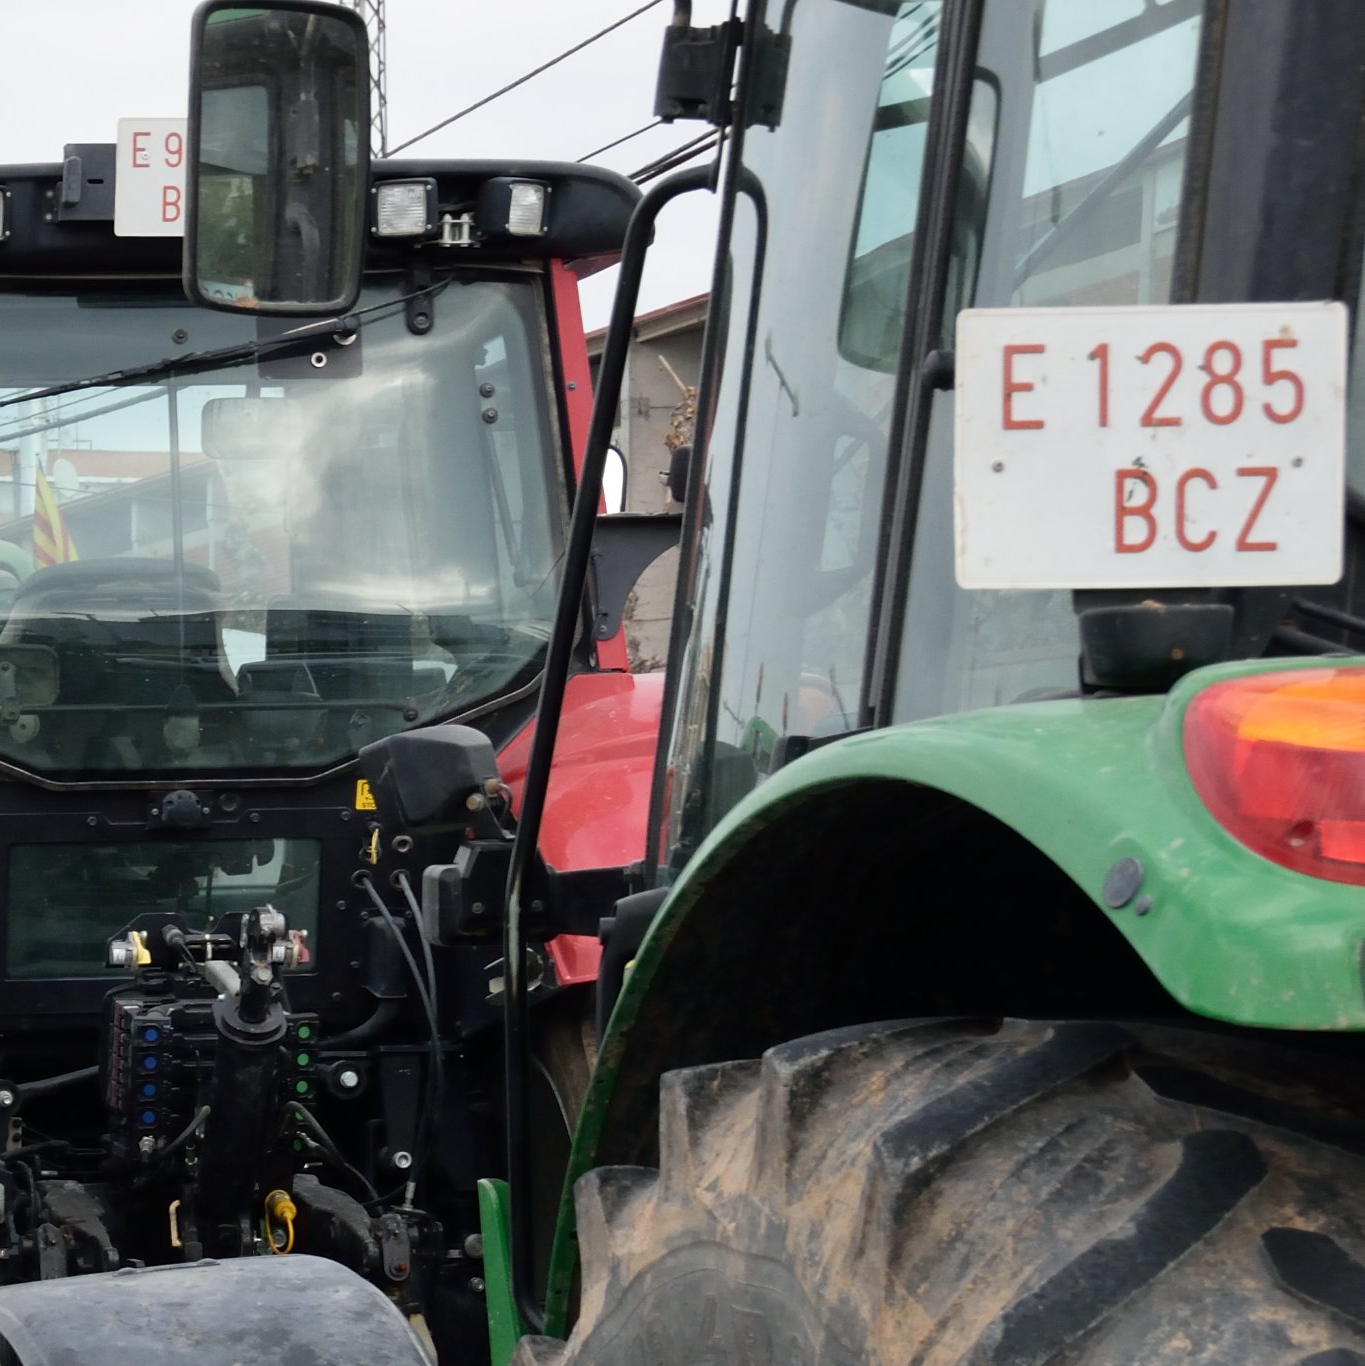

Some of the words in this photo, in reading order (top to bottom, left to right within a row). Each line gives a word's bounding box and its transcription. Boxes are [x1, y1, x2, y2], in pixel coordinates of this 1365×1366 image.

[1002, 343, 1046, 431] E
[1087, 338, 1305, 429] 1285
[1114, 465, 1280, 555] BCZ
